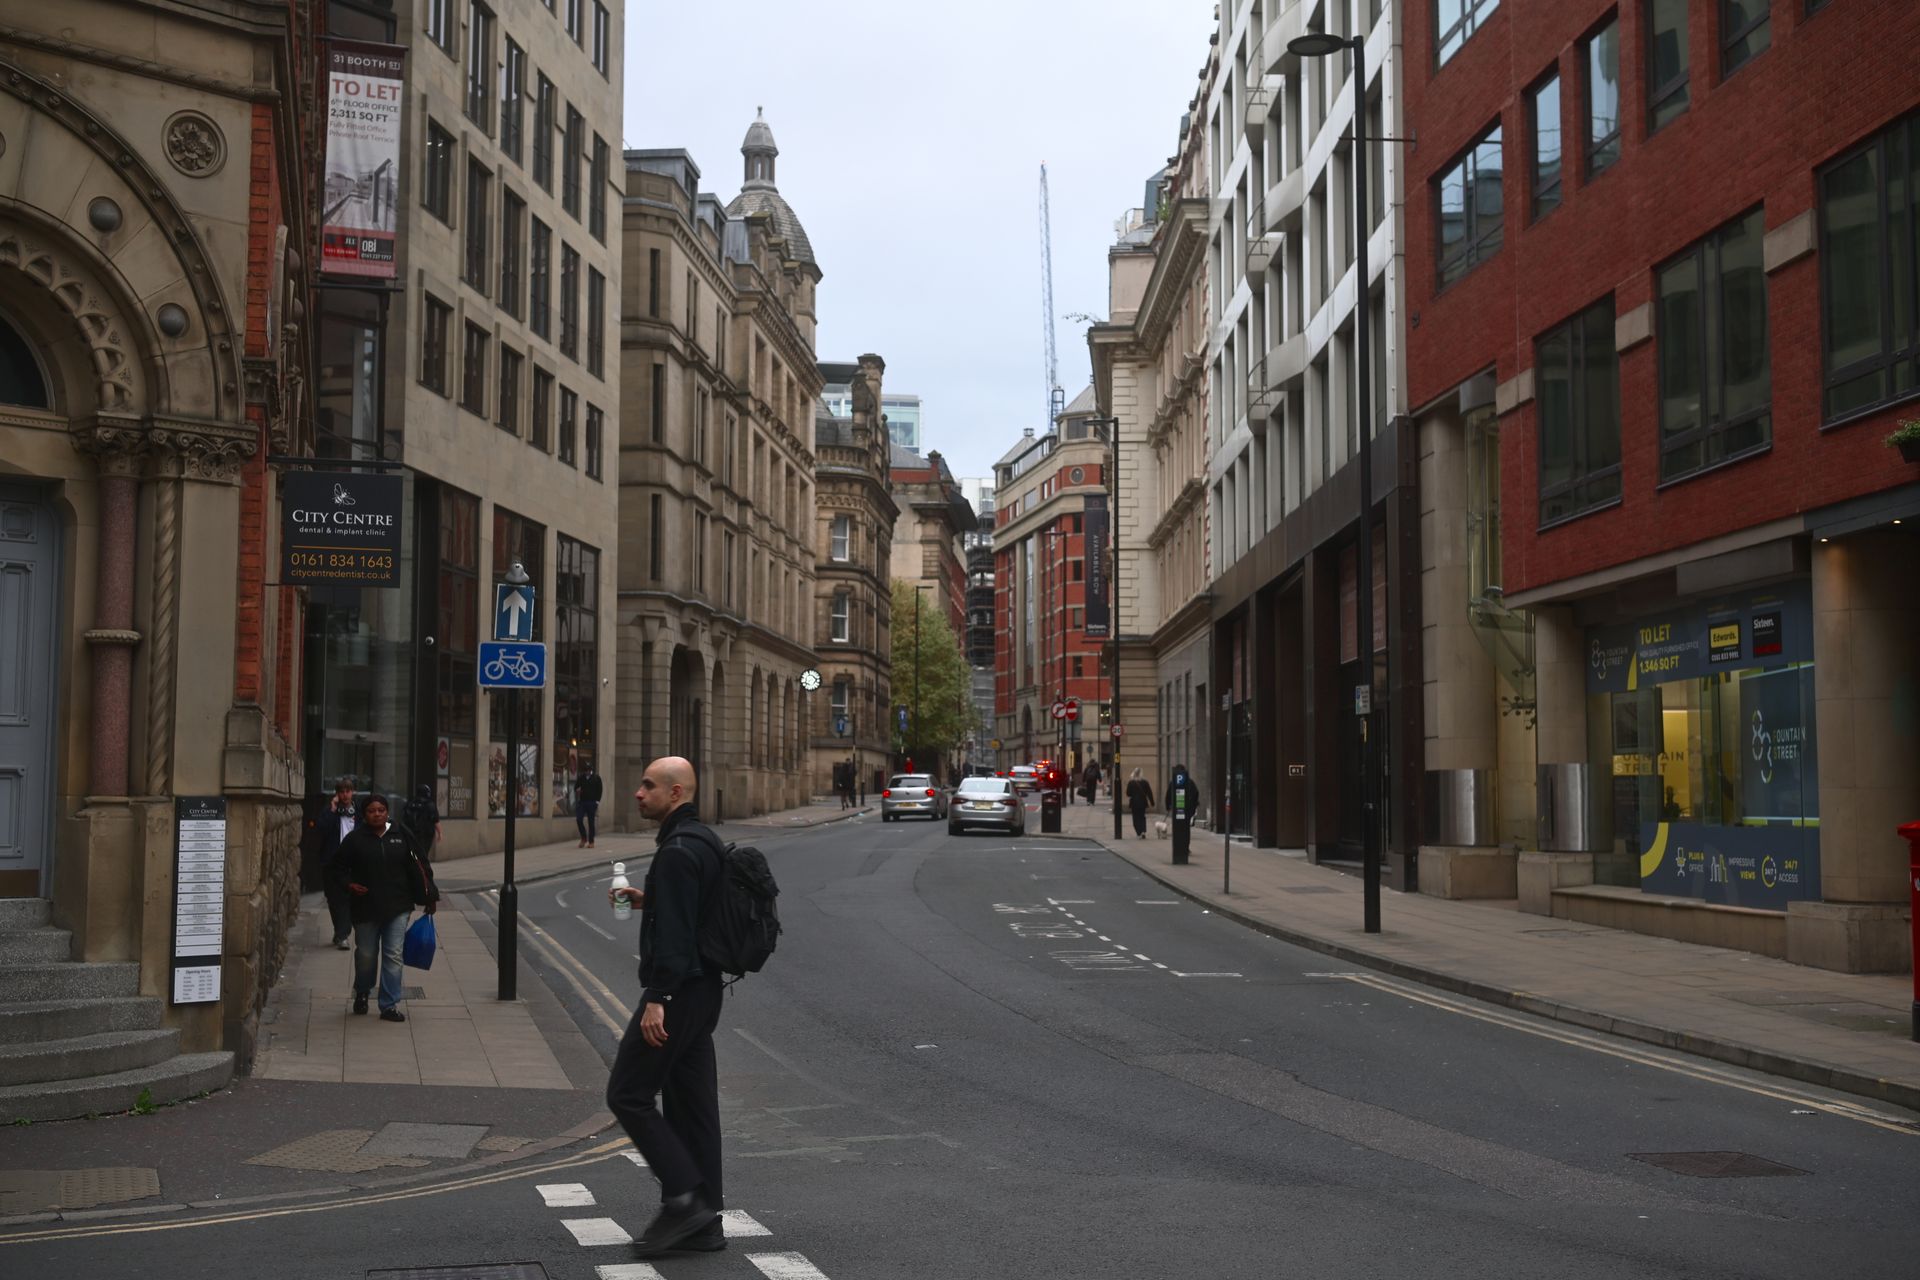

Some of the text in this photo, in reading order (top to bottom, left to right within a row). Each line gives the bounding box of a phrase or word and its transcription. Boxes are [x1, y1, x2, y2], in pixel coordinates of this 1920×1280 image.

[333, 54, 345, 63] 31
[347, 56, 386, 69] BOOTH
[332, 79, 401, 101] TO LET
[344, 100, 370, 109] FLOOR
[371, 103, 399, 113] OFFICE
[330, 108, 357, 120] 2,311
[359, 111, 374, 123] SQ
[376, 113, 389, 123] FT
[367, 124, 387, 133] Office
[371, 133, 395, 144] Terrace
[292, 509, 393, 527] CITY CENTRE
[299, 526, 386, 537] dental & implant clinic
[291, 552, 392, 569] 0161 834 1643
[291, 568, 391, 581] citycentredentist.co.uk
[1640, 624, 1671, 645] TO LET
[1606, 646, 1629, 657] FOUNTAIN
[1606, 656, 1624, 667] STREET
[1659, 659, 1670, 671] SQ
[1671, 655, 1681, 669] FT
[1773, 744, 1798, 761] STREET
[1176, 774, 1184, 785] P
[1688, 864, 1705, 873] OFFICE
[1728, 857, 1756, 868] IMPRESSIVE
[1740, 871, 1756, 880] VIEWS
[1778, 873, 1799, 884] ACCESS
